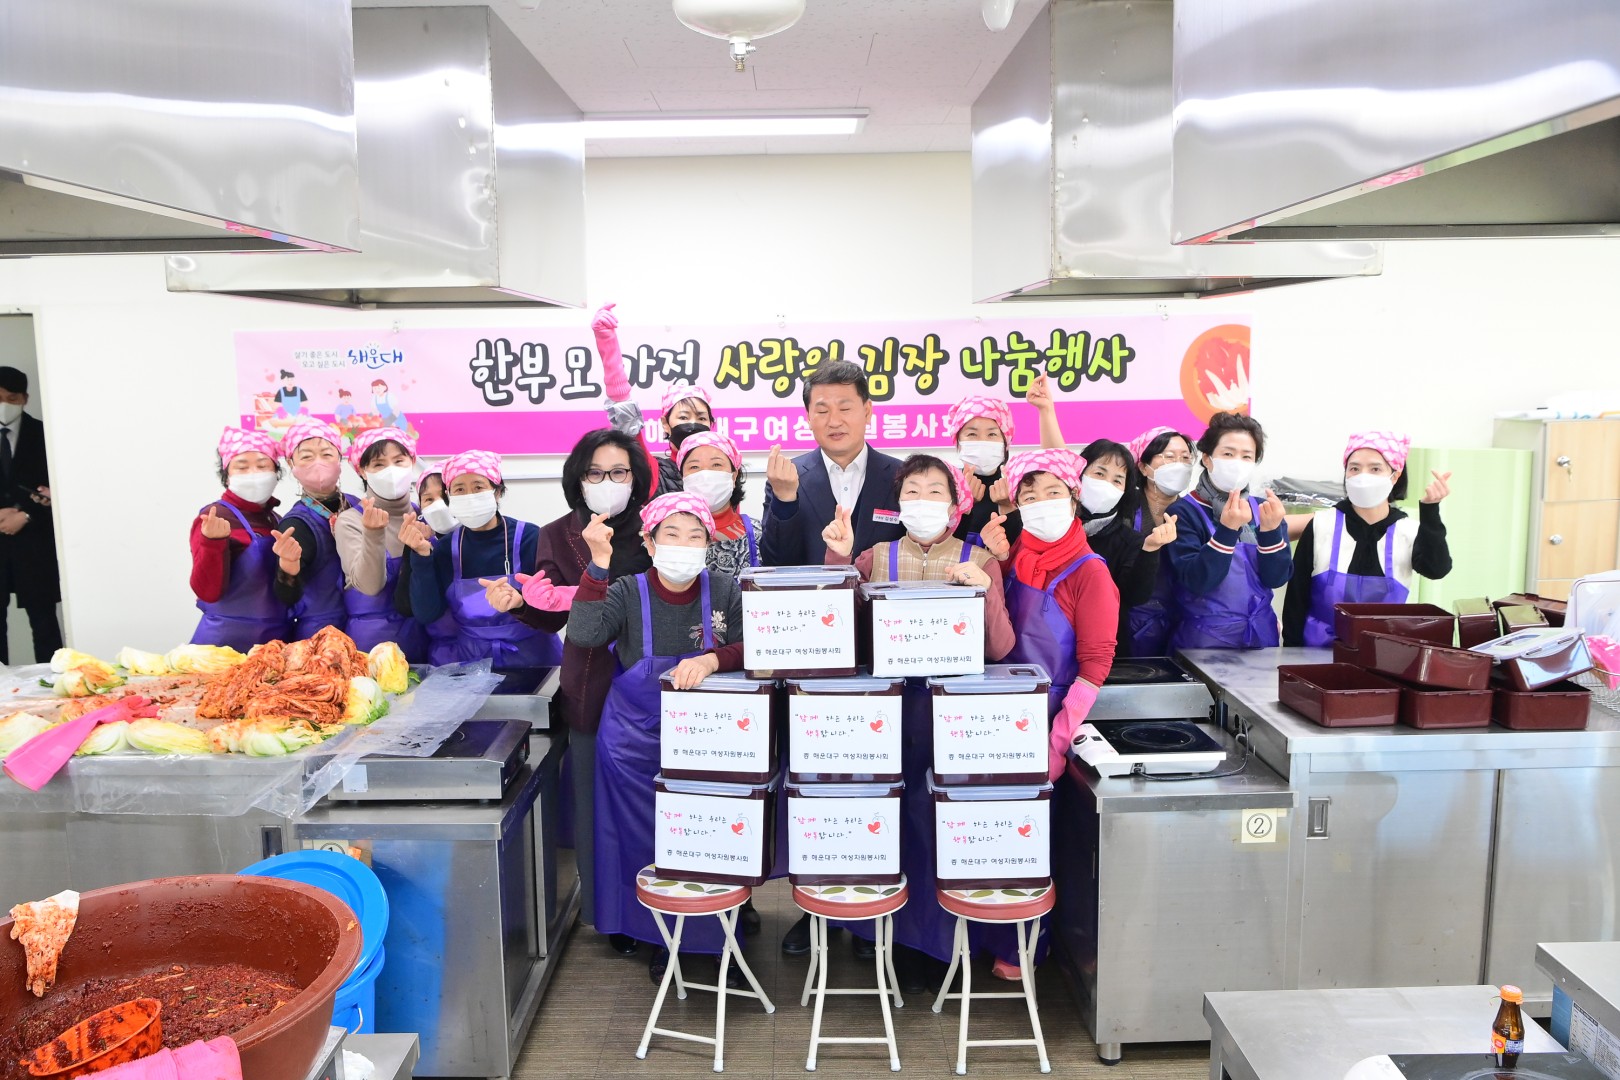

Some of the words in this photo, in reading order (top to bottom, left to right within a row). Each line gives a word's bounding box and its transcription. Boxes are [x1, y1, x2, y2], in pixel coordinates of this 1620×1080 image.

[347, 348, 403, 369] 해운대
[714, 337, 845, 397] 사랑의
[858, 333, 950, 401] 김장
[960, 328, 1136, 398] 나눔행사
[777, 610, 791, 618] 하는
[798, 609, 817, 618] 우리는
[909, 618, 924, 626] 하는
[930, 618, 949, 626] 우리는
[765, 648, 792, 656] 해운대구
[794, 647, 841, 656] 여성자원봉사회
[897, 657, 924, 665] 해운대구
[926, 656, 972, 664] 여성자원봉사회
[694, 712, 709, 720] 하는
[714, 712, 732, 721] 우리는
[846, 715, 865, 723] 우리는
[970, 714, 985, 722] 하는
[991, 714, 1010, 722] 우리는
[682, 749, 708, 757] 해운대구
[710, 750, 756, 758] 여성자원봉사회
[813, 752, 839, 760] 해운대구
[842, 752, 889, 760] 여성자원봉사회
[988, 752, 1035, 760] 여성자원봉사회
[689, 813, 703, 822] 하는
[709, 815, 727, 824] 우리는
[823, 817, 838, 825] 하는
[844, 817, 863, 825] 우리는
[973, 820, 988, 829] 하는
[994, 820, 1013, 828] 우리는
[676, 849, 701, 858] 해운대구
[704, 852, 749, 862] 여성자원봉사회
[960, 858, 988, 866] 해운대구
[990, 857, 1037, 865] 여성자원봉사회
